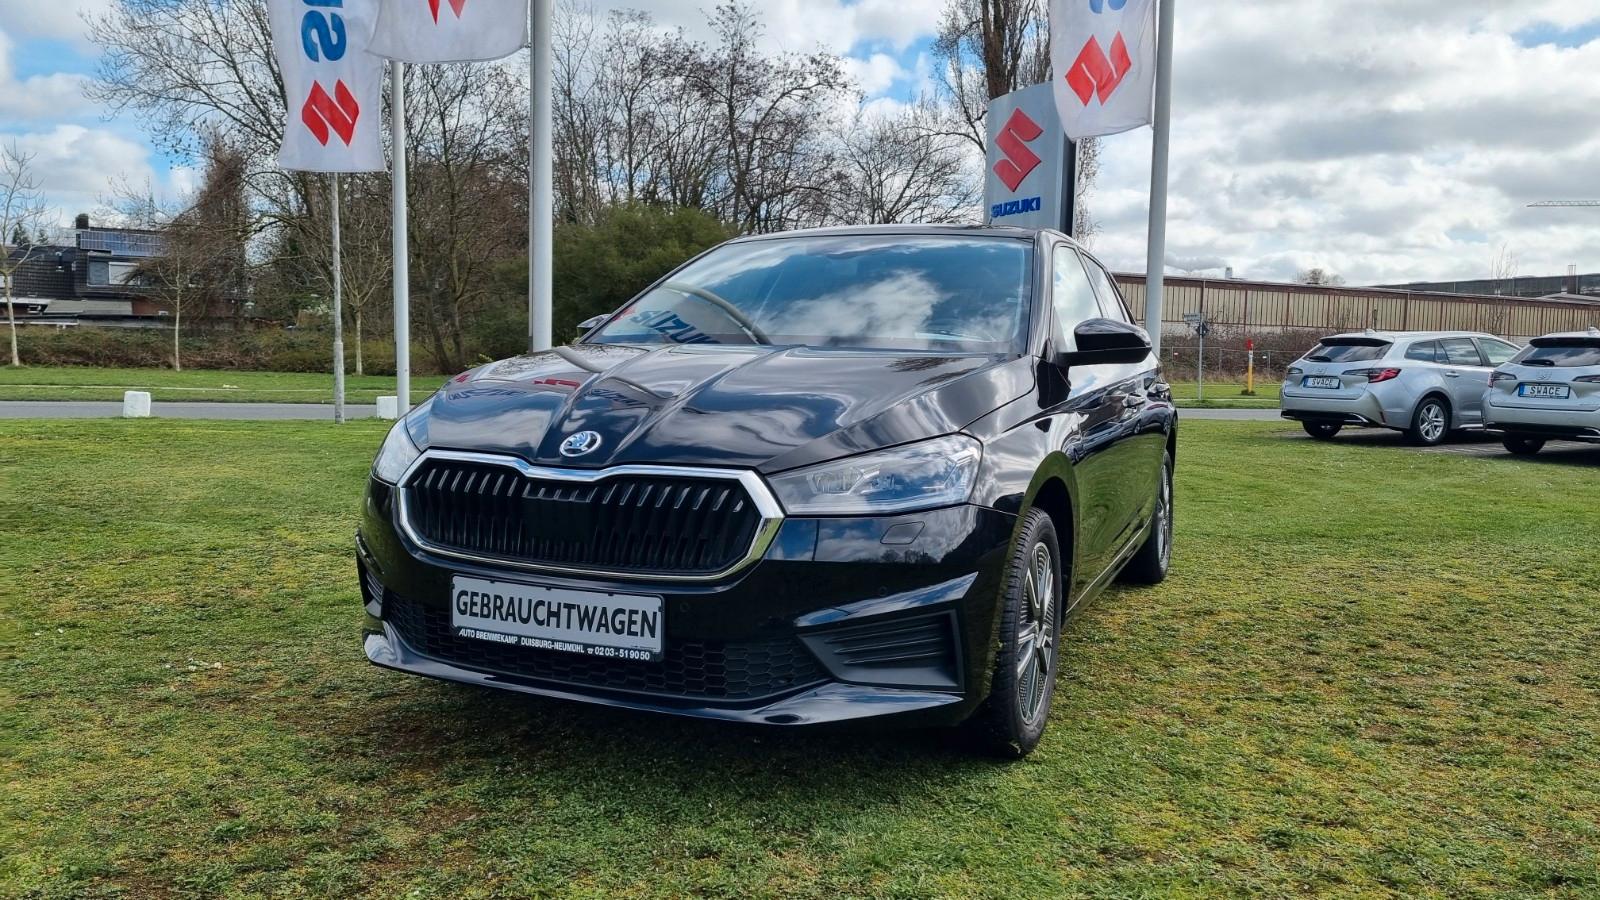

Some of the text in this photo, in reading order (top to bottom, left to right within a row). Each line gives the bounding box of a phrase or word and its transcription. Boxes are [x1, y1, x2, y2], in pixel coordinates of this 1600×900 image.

[990, 196, 1041, 218] SUZUKI
[1311, 377, 1333, 386] SWACE
[1529, 386, 1561, 396] SWACE
[456, 589, 657, 639] GEBRAUCHTWAGEN
[458, 628, 476, 638] AUTO
